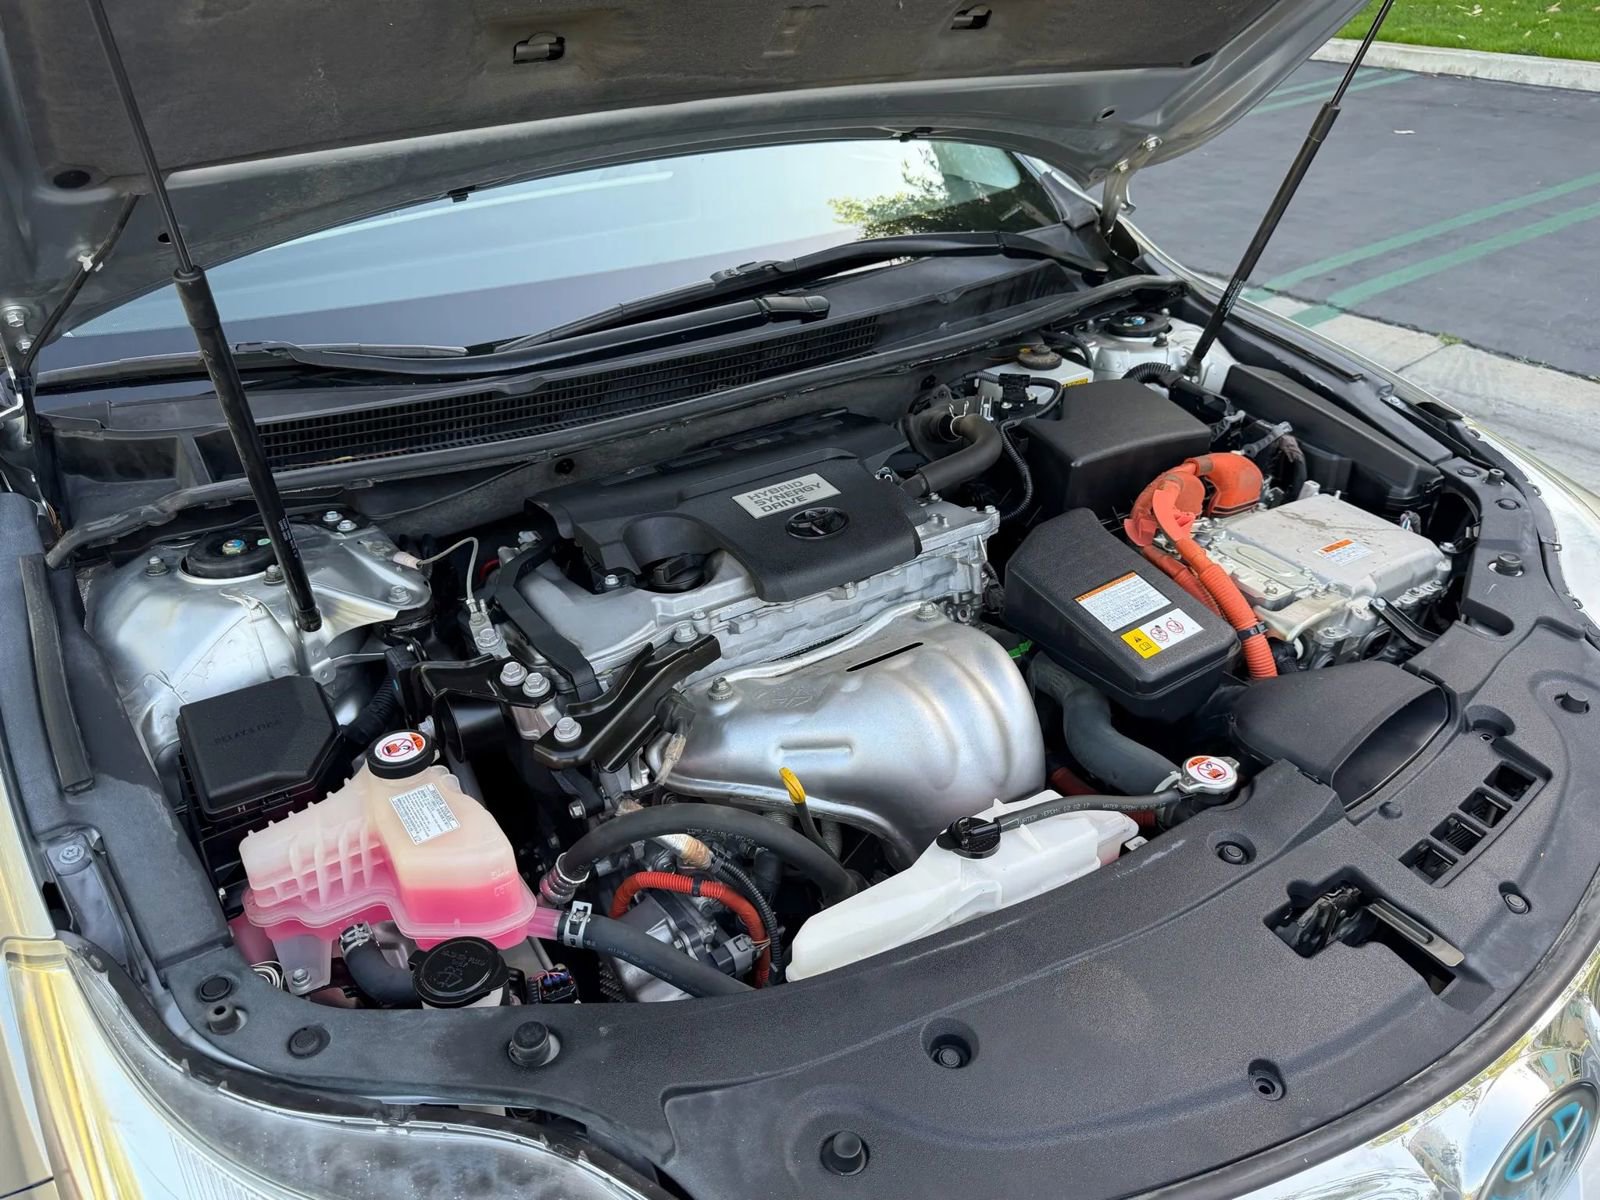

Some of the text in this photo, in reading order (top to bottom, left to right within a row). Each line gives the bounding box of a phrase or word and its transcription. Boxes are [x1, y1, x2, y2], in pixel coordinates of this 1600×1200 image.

[748, 481, 804, 500] HYBRID
[754, 482, 822, 506] SYNERGY
[761, 495, 808, 512] DRIVE
